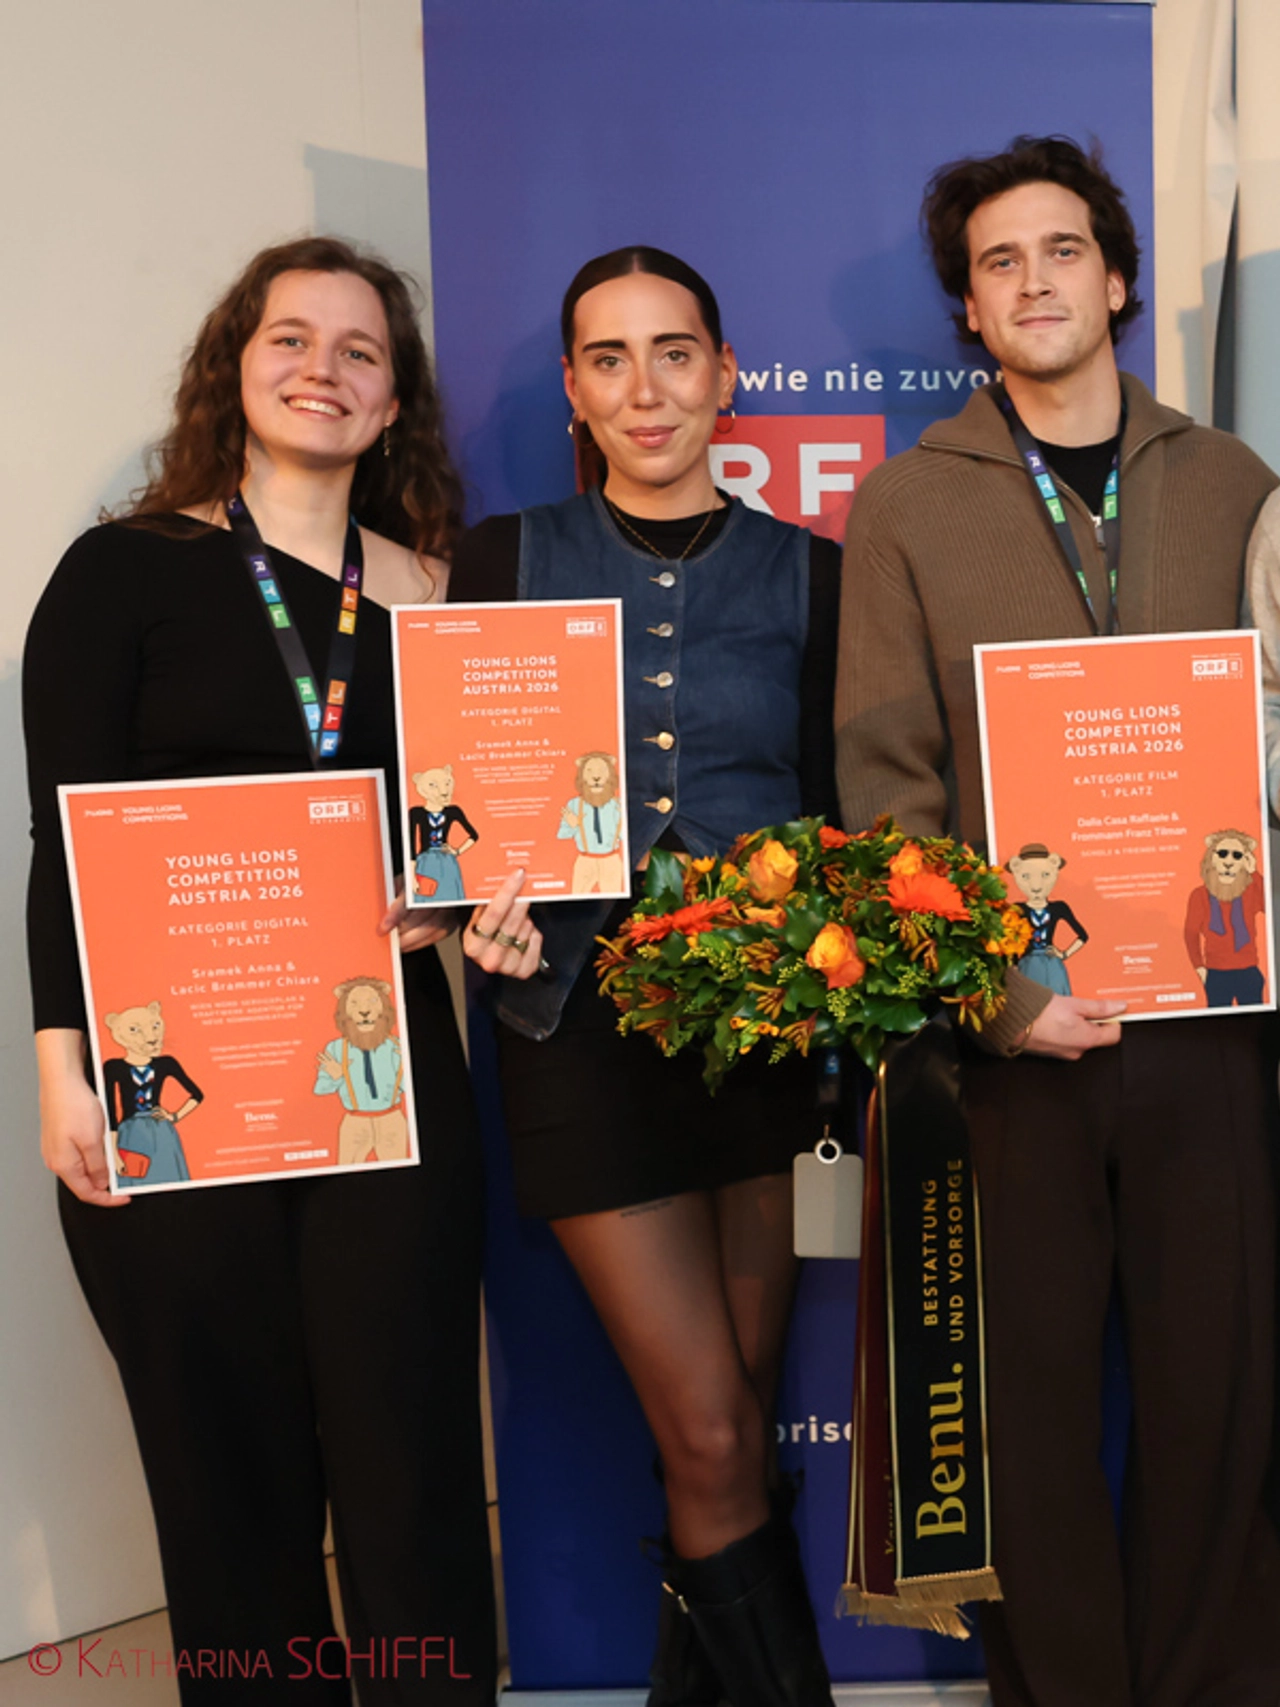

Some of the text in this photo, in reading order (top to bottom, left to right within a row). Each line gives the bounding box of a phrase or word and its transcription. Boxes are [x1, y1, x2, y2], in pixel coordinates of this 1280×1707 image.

[739, 363, 808, 391] wie
[825, 363, 883, 391] nie
[708, 443, 861, 515] RF
[253, 560, 284, 622] RTL
[463, 656, 557, 668] YOUNG LIONS
[463, 669, 557, 682] COMPETITION
[463, 683, 559, 695] AUSTRIA 2026
[322, 687, 343, 750] RTL
[461, 706, 560, 717] KATEGORIE DIGITAL
[1064, 704, 1181, 723] YOUNG LIONS
[502, 718, 533, 727] PLATZ
[1065, 722, 1181, 741] COMPETITION
[1065, 739, 1184, 758] AUSTRIA 2026
[1074, 771, 1178, 785] KATEGORIE FILM
[1101, 786, 1153, 798] 1. PLATZ
[1103, 816, 1128, 826] Casa
[1171, 812, 1179, 821] &
[1125, 829, 1152, 838] Franz
[165, 849, 298, 869] YOUNG LIONS
[167, 867, 300, 888] COMPETITION
[169, 885, 303, 905] AUSTRIA 2026
[169, 918, 308, 935] KATEGORIE DIGITAL
[212, 934, 270, 947] 1. PLATZ
[192, 962, 296, 979] Sramek Anna &
[211, 980, 271, 992] Brammer
[276, 976, 320, 987] Chiara
[924, 1179, 939, 1327] BESTATTUNG
[947, 1158, 964, 1342] UND VORSORGE
[915, 1361, 968, 1540] Benu.
